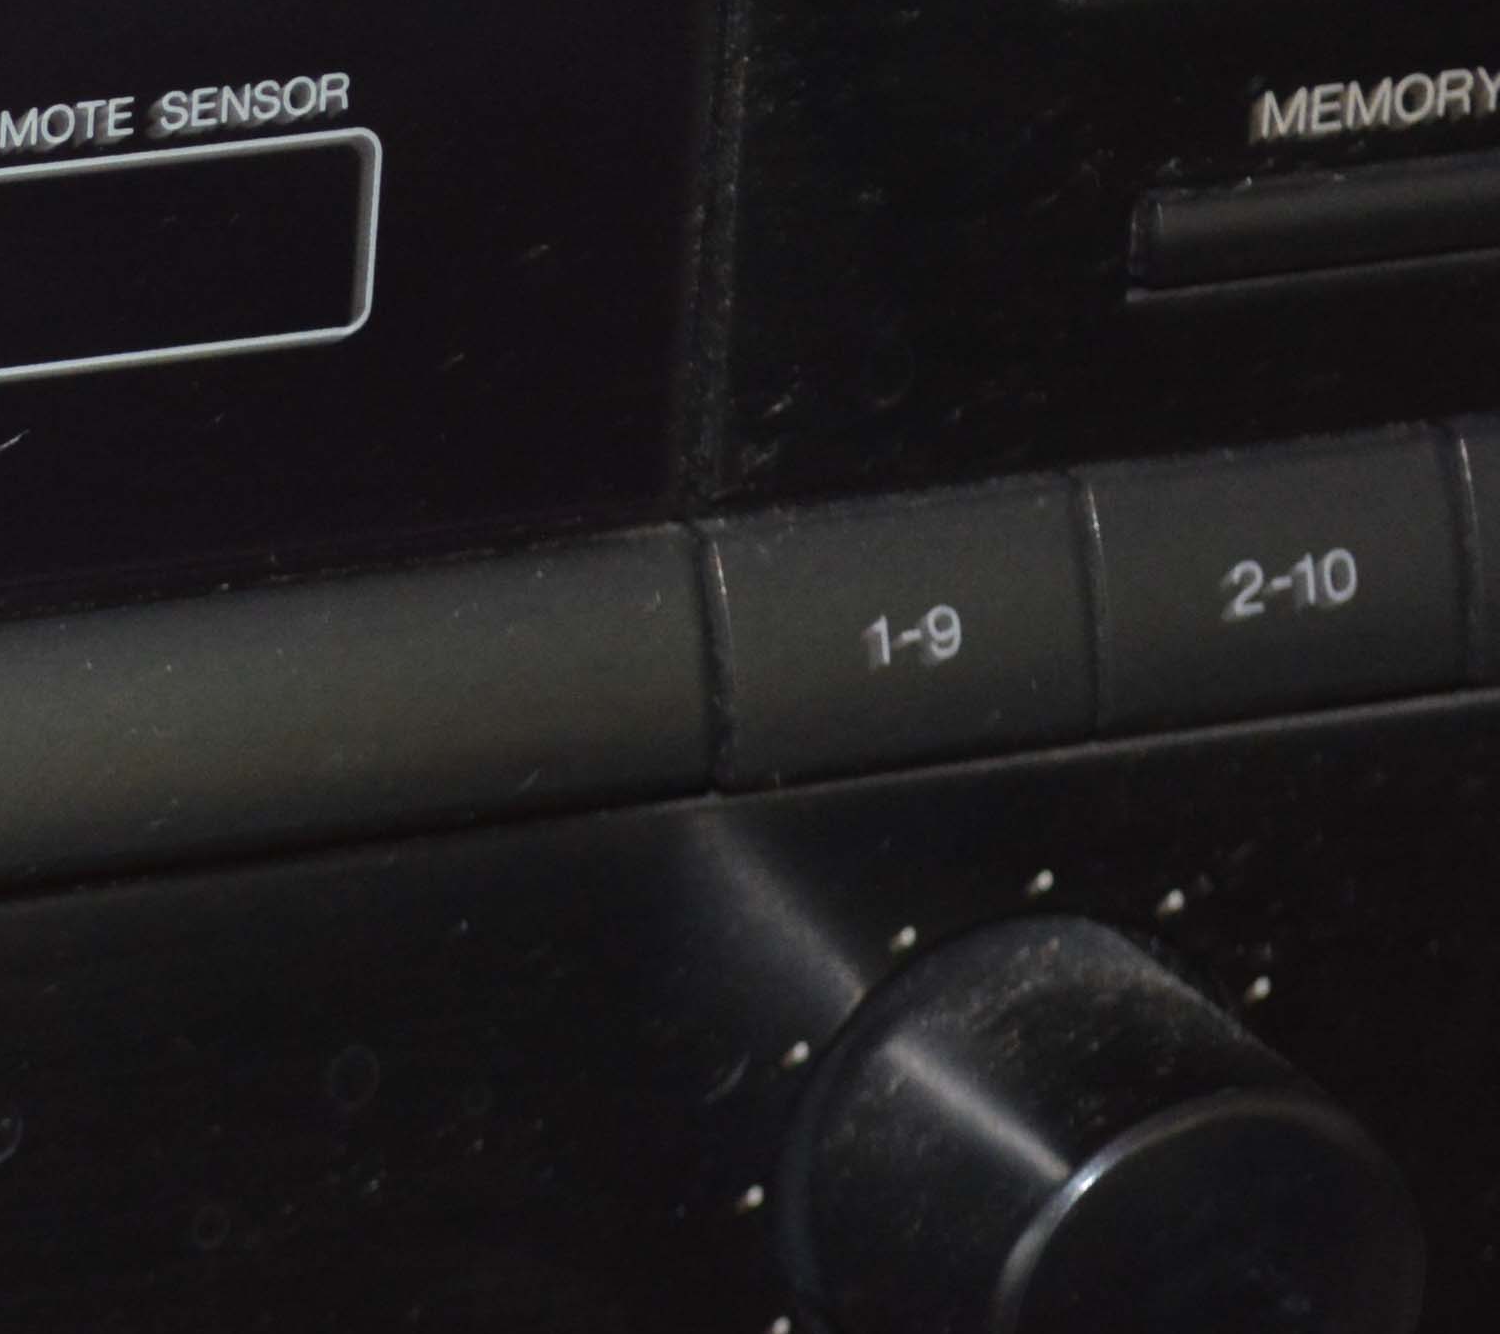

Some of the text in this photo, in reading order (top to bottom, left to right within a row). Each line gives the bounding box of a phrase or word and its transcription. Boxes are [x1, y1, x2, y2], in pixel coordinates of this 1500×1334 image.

[156, 72, 350, 133] SENSOR
[1255, 65, 1500, 139] MEMORY
[1225, 547, 1360, 617] 2-10
[870, 605, 962, 665] 1-9
